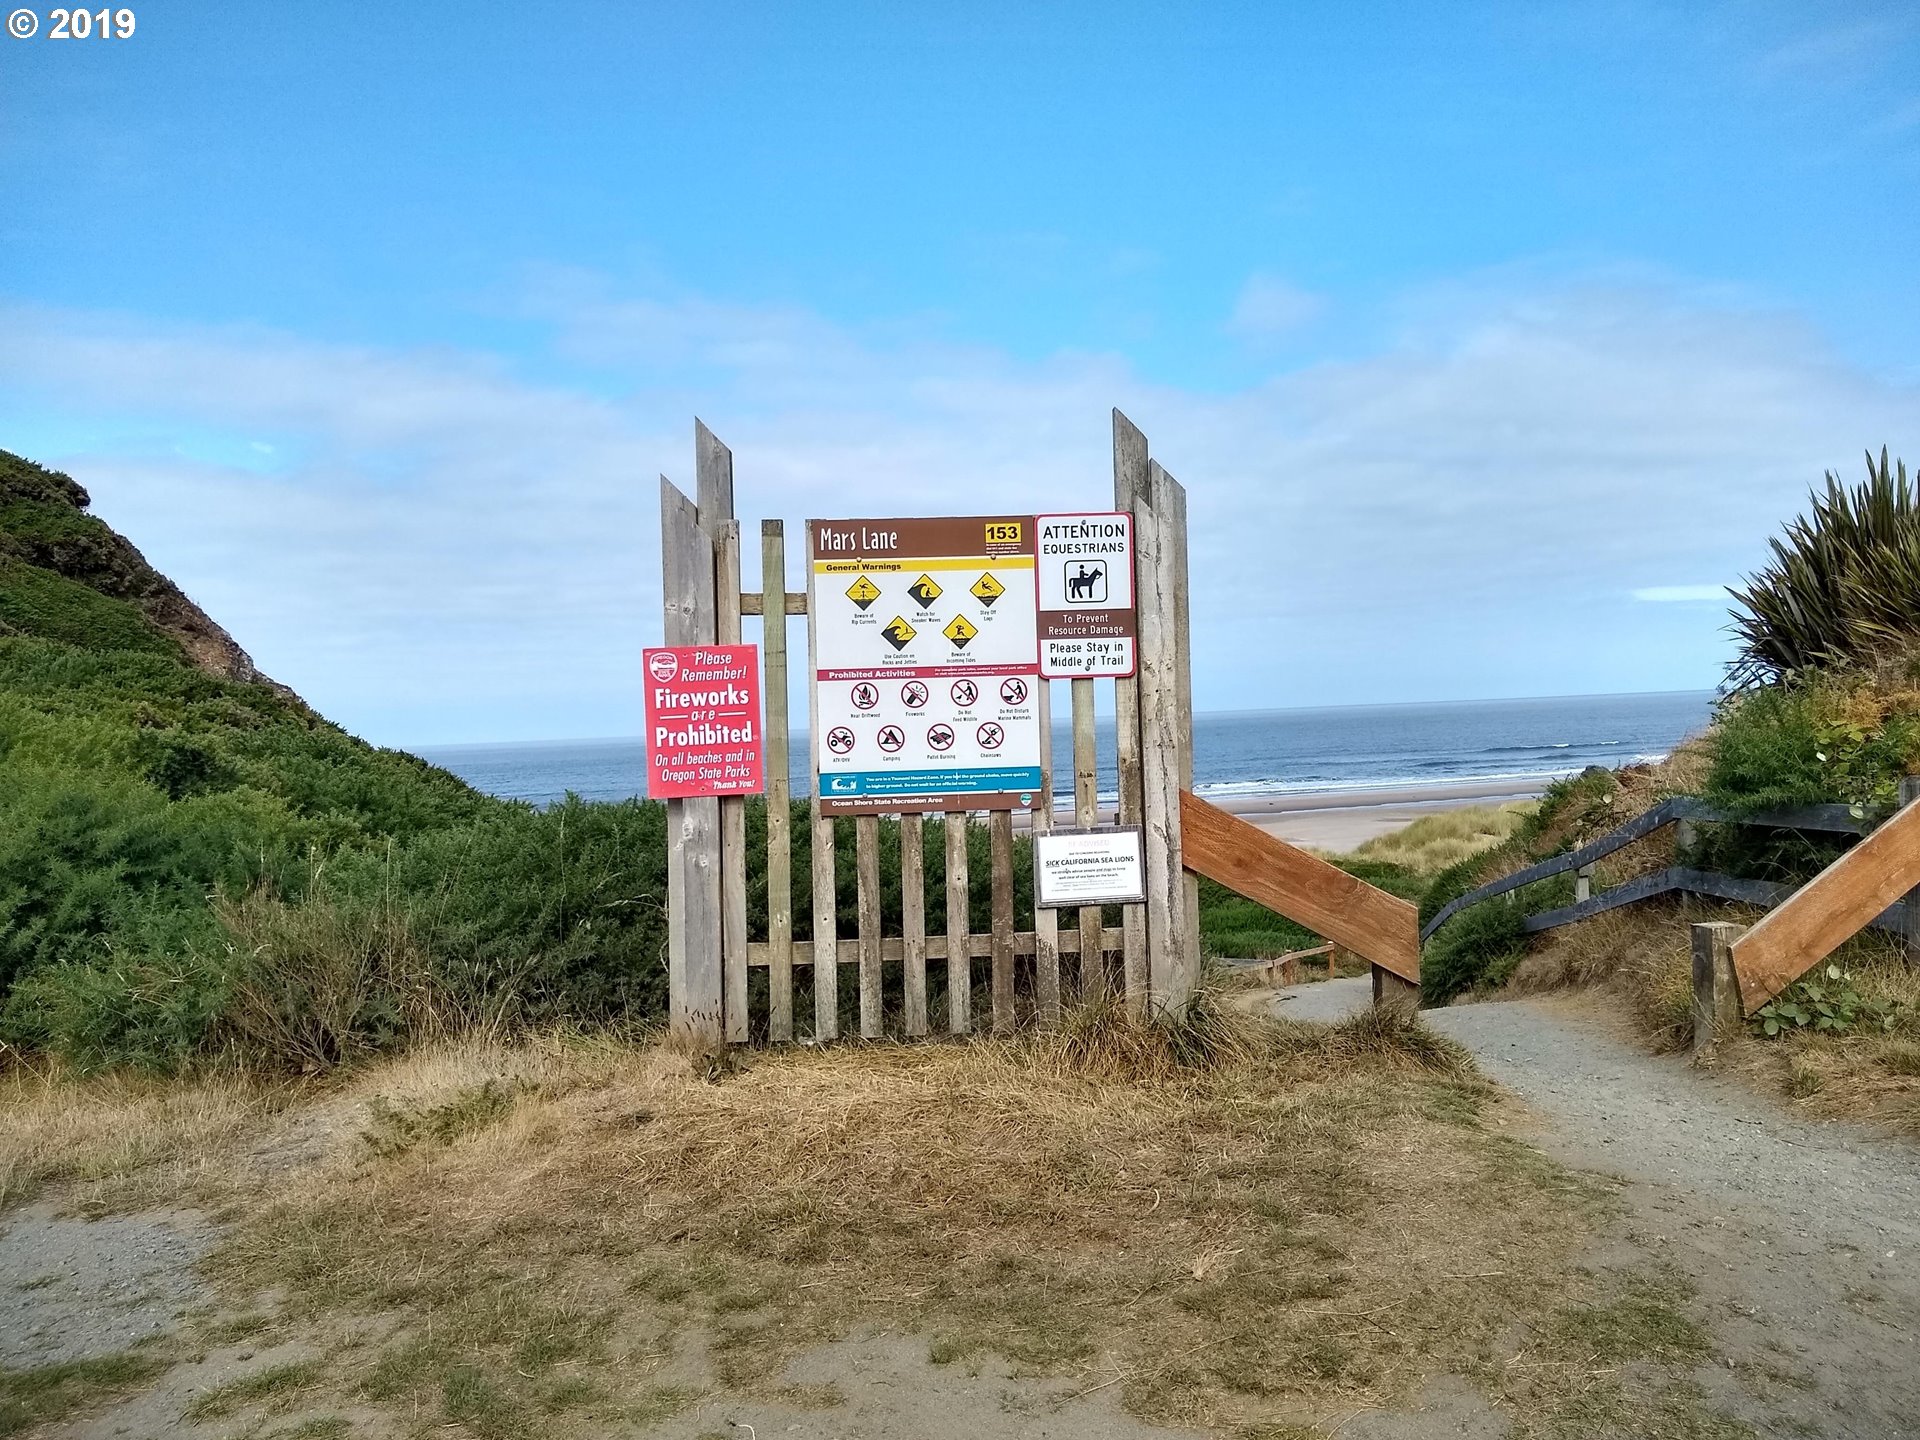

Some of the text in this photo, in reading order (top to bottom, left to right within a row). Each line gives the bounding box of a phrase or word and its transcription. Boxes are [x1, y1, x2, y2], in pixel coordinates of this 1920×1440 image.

[986, 526, 1018, 540] 153
[1043, 524, 1125, 539] ATTENTION
[820, 527, 898, 551] Mars Lane
[1043, 542, 1125, 555] EQUESTRIANS
[826, 563, 901, 572] General Warnings
[1063, 613, 1109, 623] To Prevent
[1048, 625, 1124, 636] Resource Damage
[1050, 642, 1123, 654] Please Stay in
[695, 651, 732, 665] Please
[1050, 655, 1124, 667] Middle of Trail
[681, 665, 747, 682] Remember!
[829, 670, 916, 679] Prohibited Activities
[655, 683, 749, 709] Fireworks
[691, 709, 716, 721] are
[656, 721, 752, 747] Prohibited
[655, 749, 755, 767] On all beaches and in
[661, 764, 751, 784] Oregon State Parks
[713, 779, 756, 790] Thank You!
[892, 797, 926, 805] Recreation
[1061, 858, 1100, 866] CALIFORNIA
